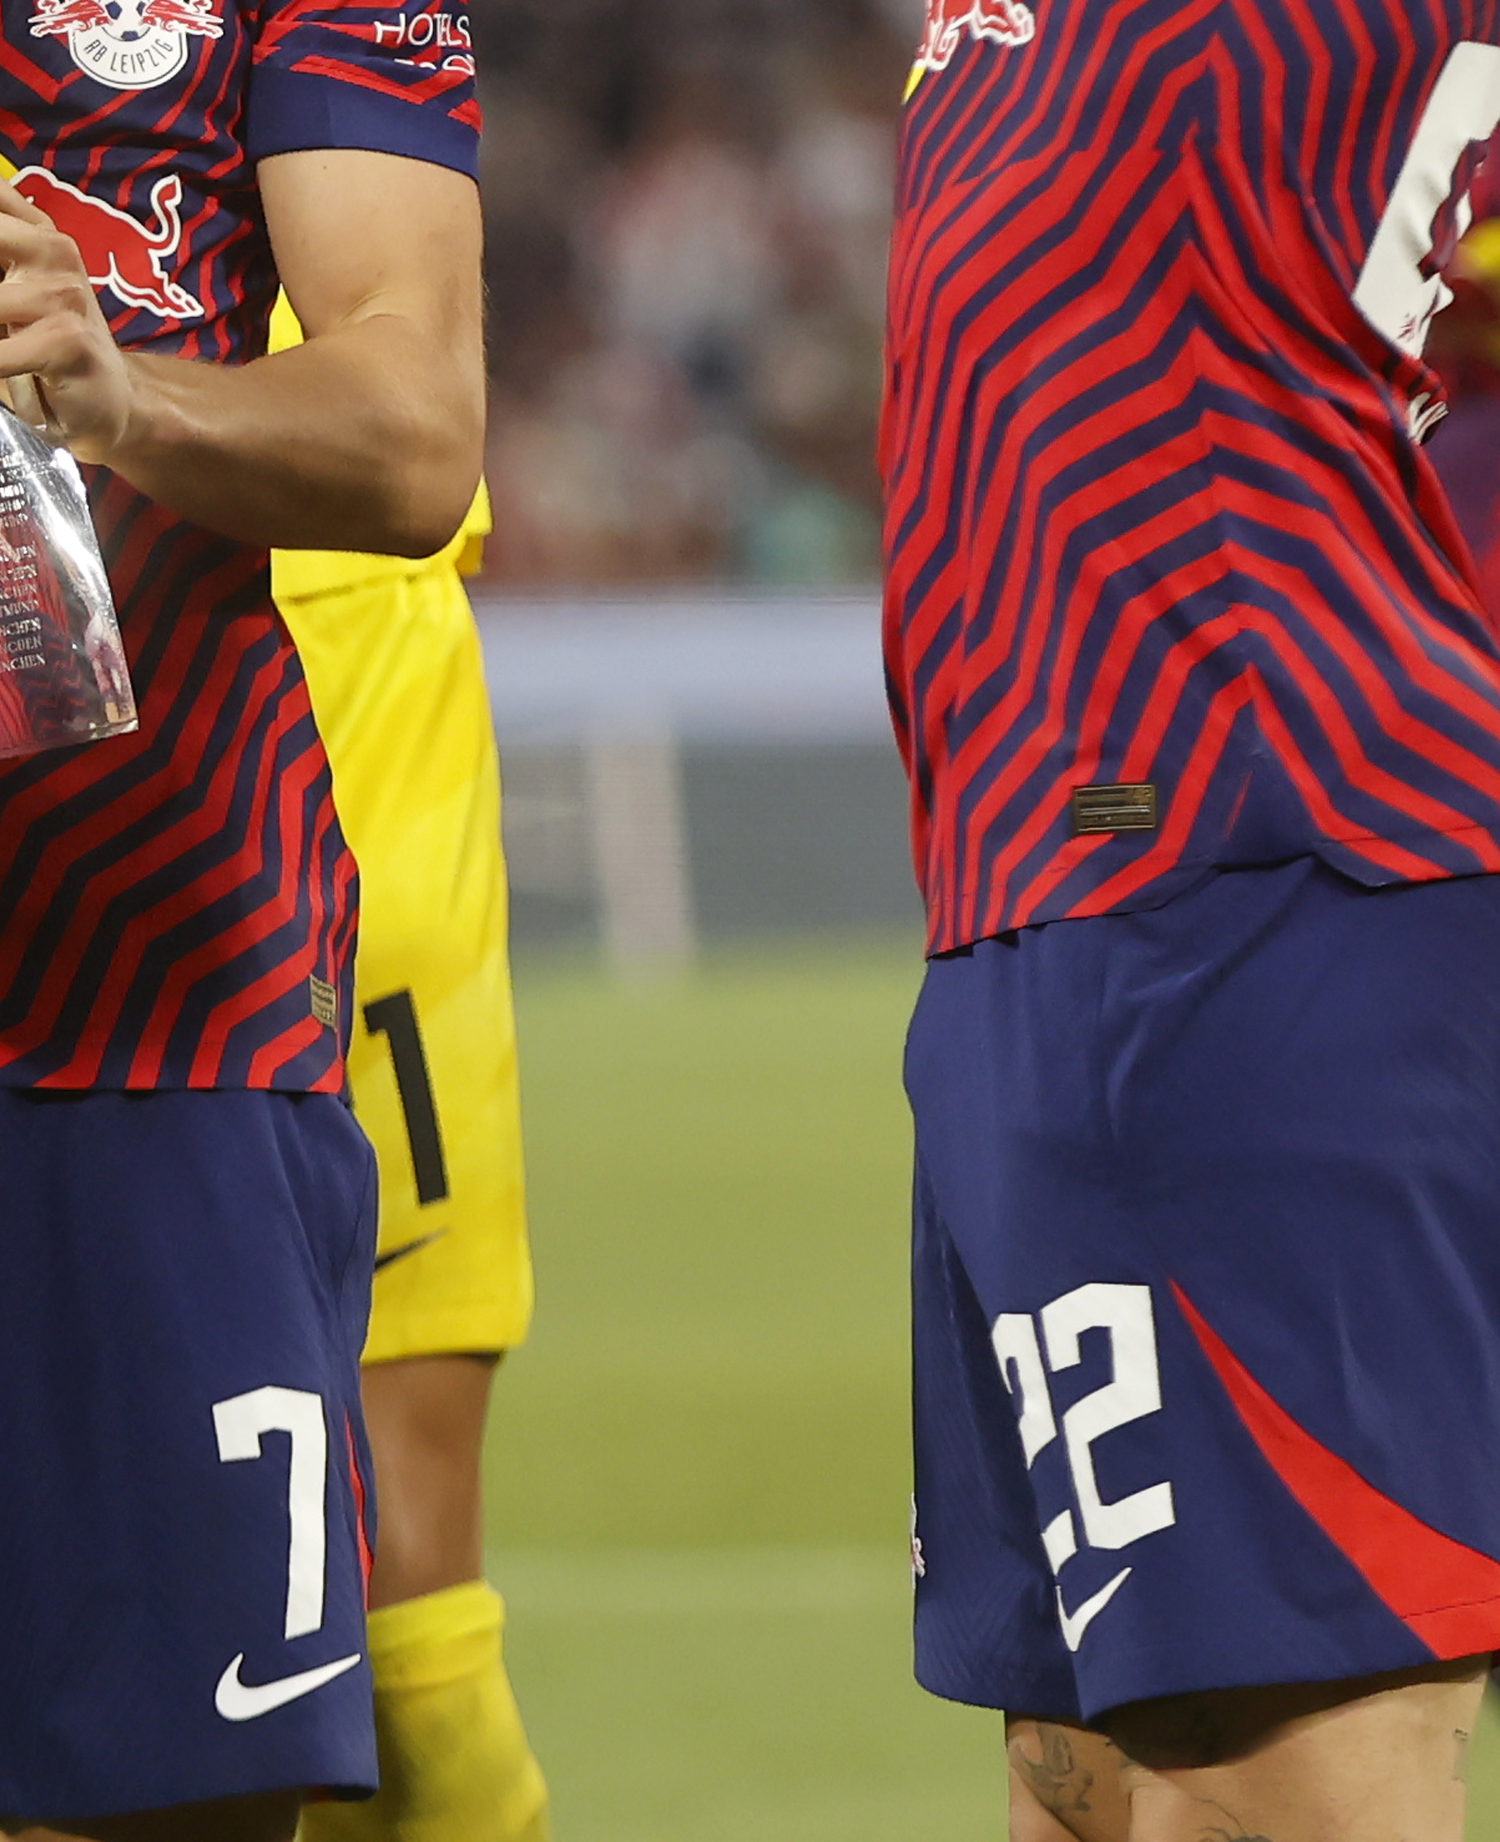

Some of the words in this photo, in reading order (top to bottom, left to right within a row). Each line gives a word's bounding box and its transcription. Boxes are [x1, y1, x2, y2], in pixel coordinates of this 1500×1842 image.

[83, 39, 108, 62] RB
[110, 38, 174, 74] LEIPZIG
[373, 13, 472, 48] HOTELS
[363, 987, 451, 1208] 1
[212, 1386, 327, 1641] 7
